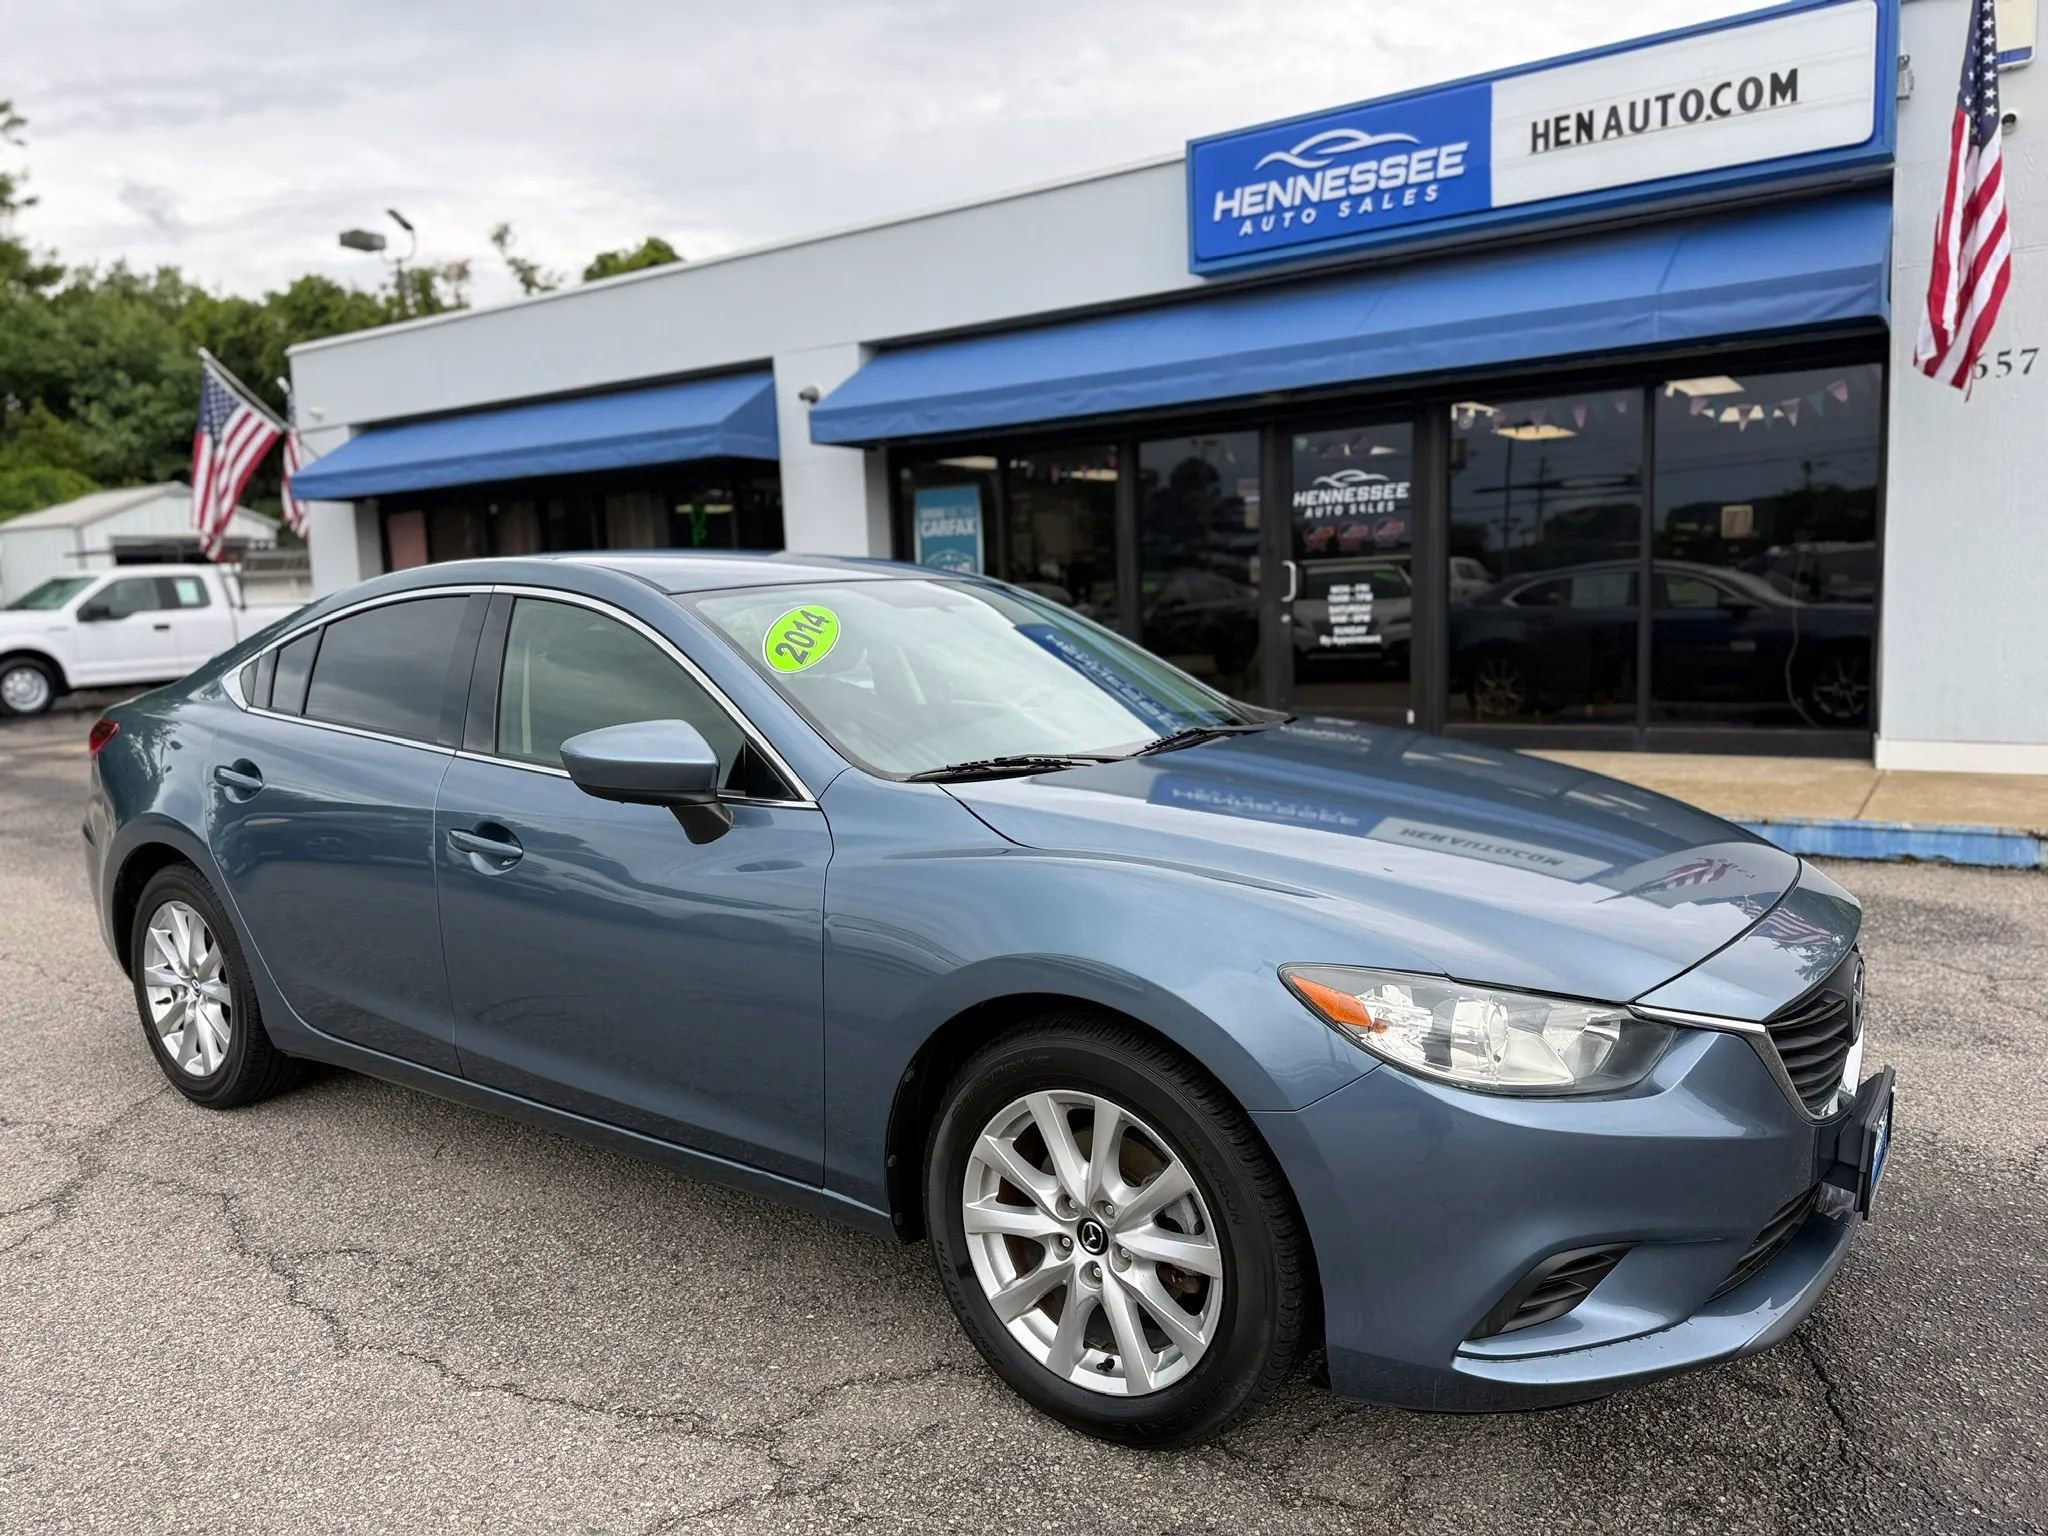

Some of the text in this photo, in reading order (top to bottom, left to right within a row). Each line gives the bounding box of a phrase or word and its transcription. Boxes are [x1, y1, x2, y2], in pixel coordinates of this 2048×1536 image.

[1531, 68, 1799, 153] HENAUTO.COM
[1213, 141, 1470, 222] HENNESSEE
[1239, 185, 1440, 237] AUTO SALES
[1293, 482, 1410, 507] HENNESSEE
[1304, 501, 1395, 519] AUTO SALES
[775, 610, 830, 665] 2014
